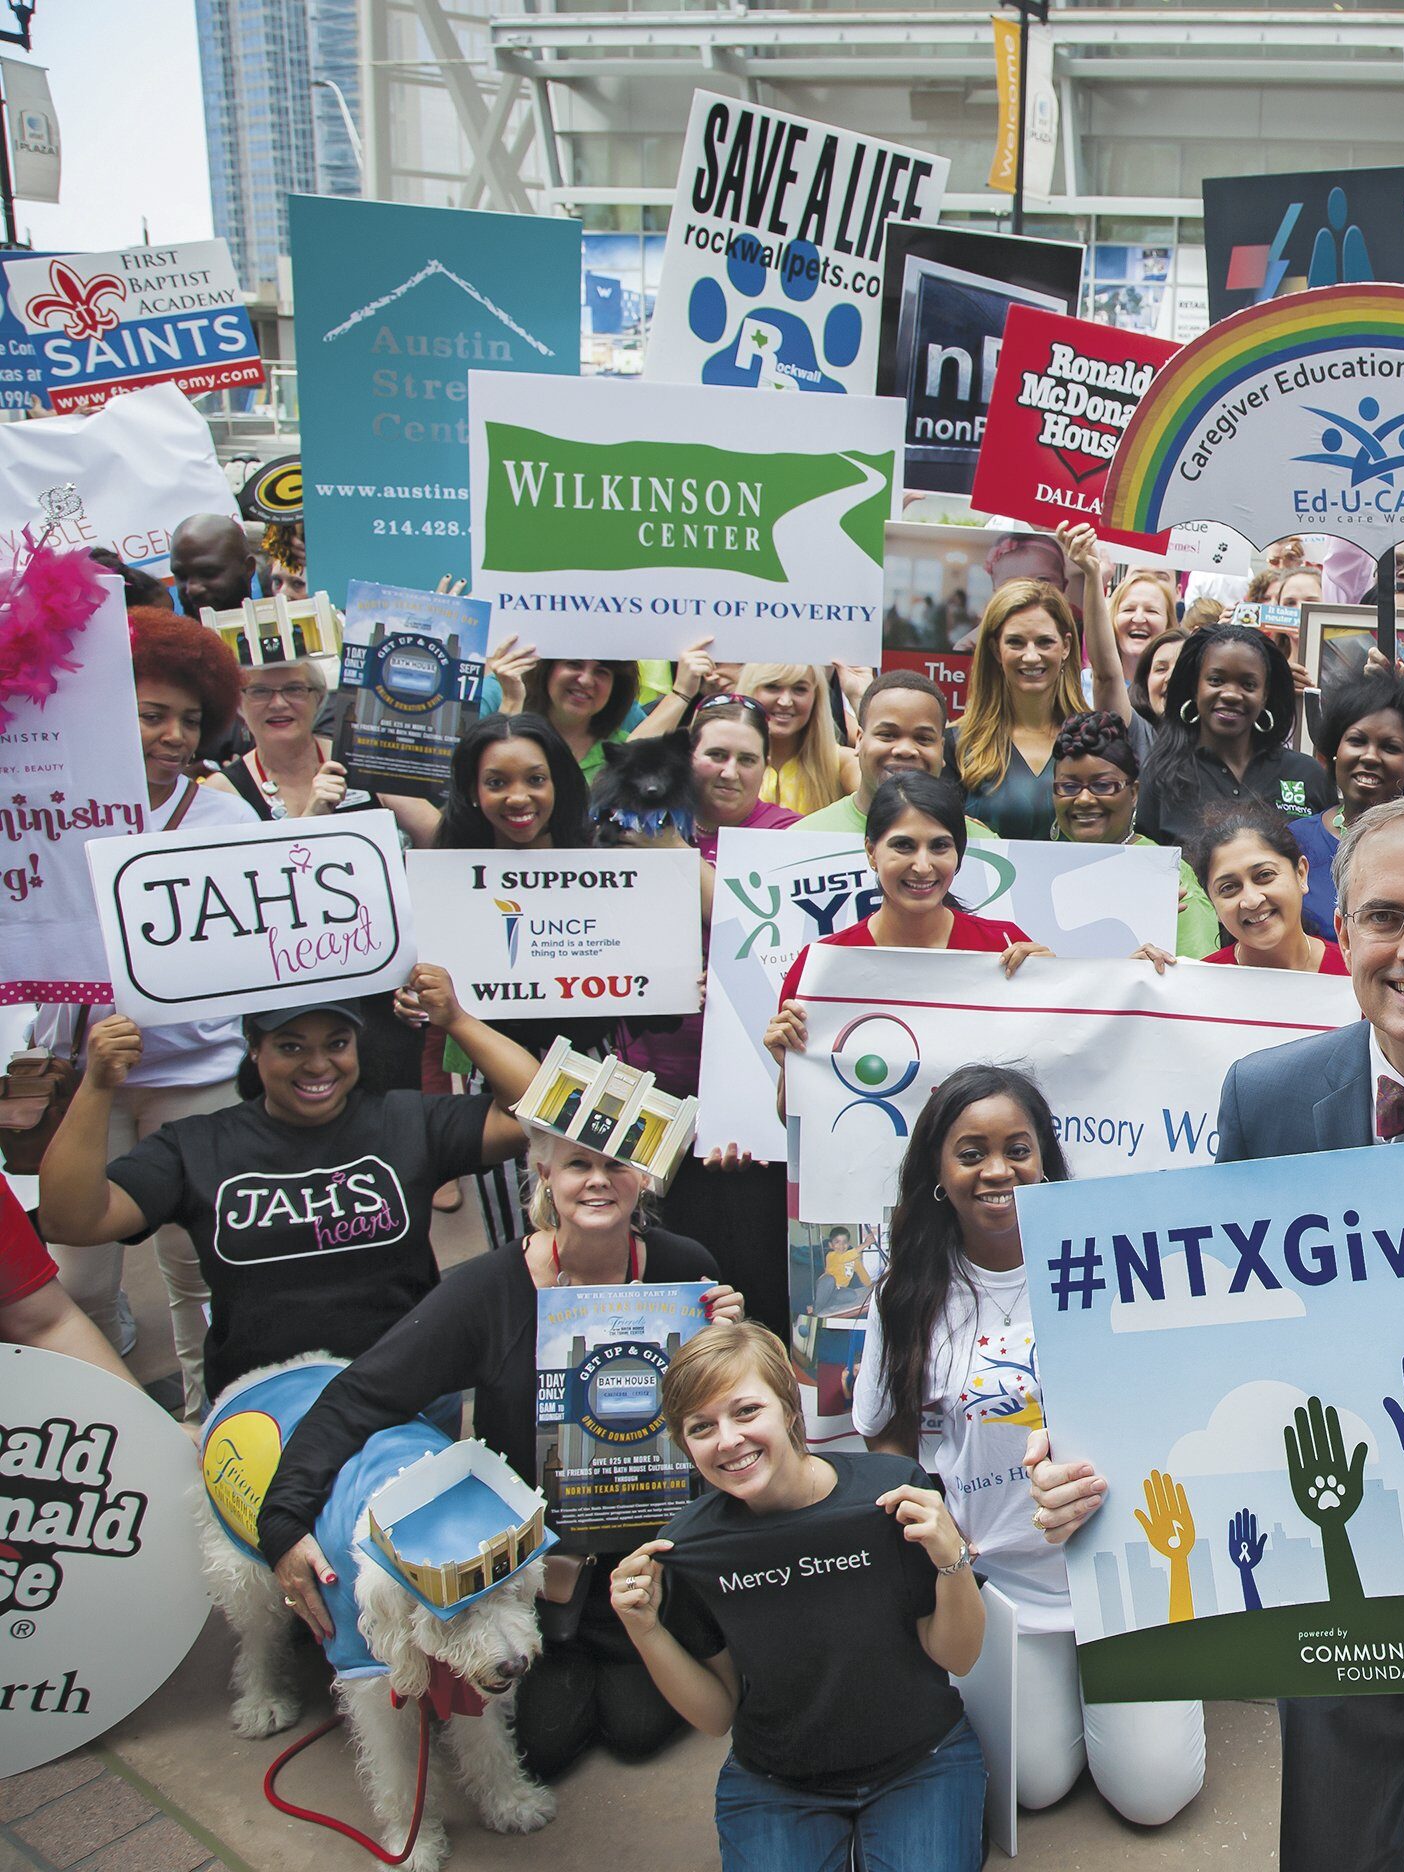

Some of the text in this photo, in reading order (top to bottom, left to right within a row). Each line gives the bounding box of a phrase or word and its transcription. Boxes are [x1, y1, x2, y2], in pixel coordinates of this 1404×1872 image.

[692, 103, 933, 262] SAVE A LIFE
[120, 250, 179, 270] FIRST
[684, 224, 881, 298] rockwallpets.co
[128, 270, 211, 293] BAPTIST
[139, 289, 236, 315] ACADEMY
[43, 314, 248, 378] SAINTS
[371, 325, 514, 362] Austin
[1047, 343, 1155, 398] Ronald
[372, 369, 468, 401] Stre
[1180, 382, 1271, 483] Caregiver
[502, 460, 765, 517] WILKINSON
[1035, 484, 1104, 515] DALLA
[1296, 514, 1326, 524] You
[1337, 516, 1373, 524] care
[638, 522, 760, 552] CENTER
[498, 593, 643, 614] PATHWAYS
[651, 598, 706, 617] OUT
[713, 600, 749, 618] OF
[756, 602, 877, 623] POVERTY
[399, 636, 413, 645] UP
[459, 663, 482, 676] SEPT
[924, 662, 966, 683] The
[457, 676, 480, 701] 17
[25, 763, 65, 773] BEAUTY
[1275, 802, 1313, 815] women's
[472, 865, 638, 890] I SUPPORT
[790, 870, 868, 898] JUST
[141, 843, 361, 947] JAH'S
[530, 919, 597, 935] UNCF
[268, 904, 382, 981] heart
[531, 939, 538, 947] A
[541, 939, 565, 947] mind
[567, 939, 575, 947] is
[586, 938, 621, 947] terrible
[531, 950, 556, 959] thing
[471, 975, 650, 1002] WILL YOU?
[314, 1198, 400, 1250] heart
[580, 1345, 639, 1382] GET UP &
[545, 1373, 566, 1389] DAY
[598, 1375, 656, 1387] BATH HOUSE
[538, 1388, 566, 1401] ONLY
[539, 1402, 556, 1414] 6AM
[608, 1428, 649, 1442] DONATION
[592, 1456, 651, 1466] GIVE MORE
[565, 1482, 650, 1496] NORTH TEXAS GIVING
[956, 1472, 1004, 1494] Della's
[718, 1549, 872, 1594] Mercy Street
[1298, 1627, 1348, 1641] powered by
